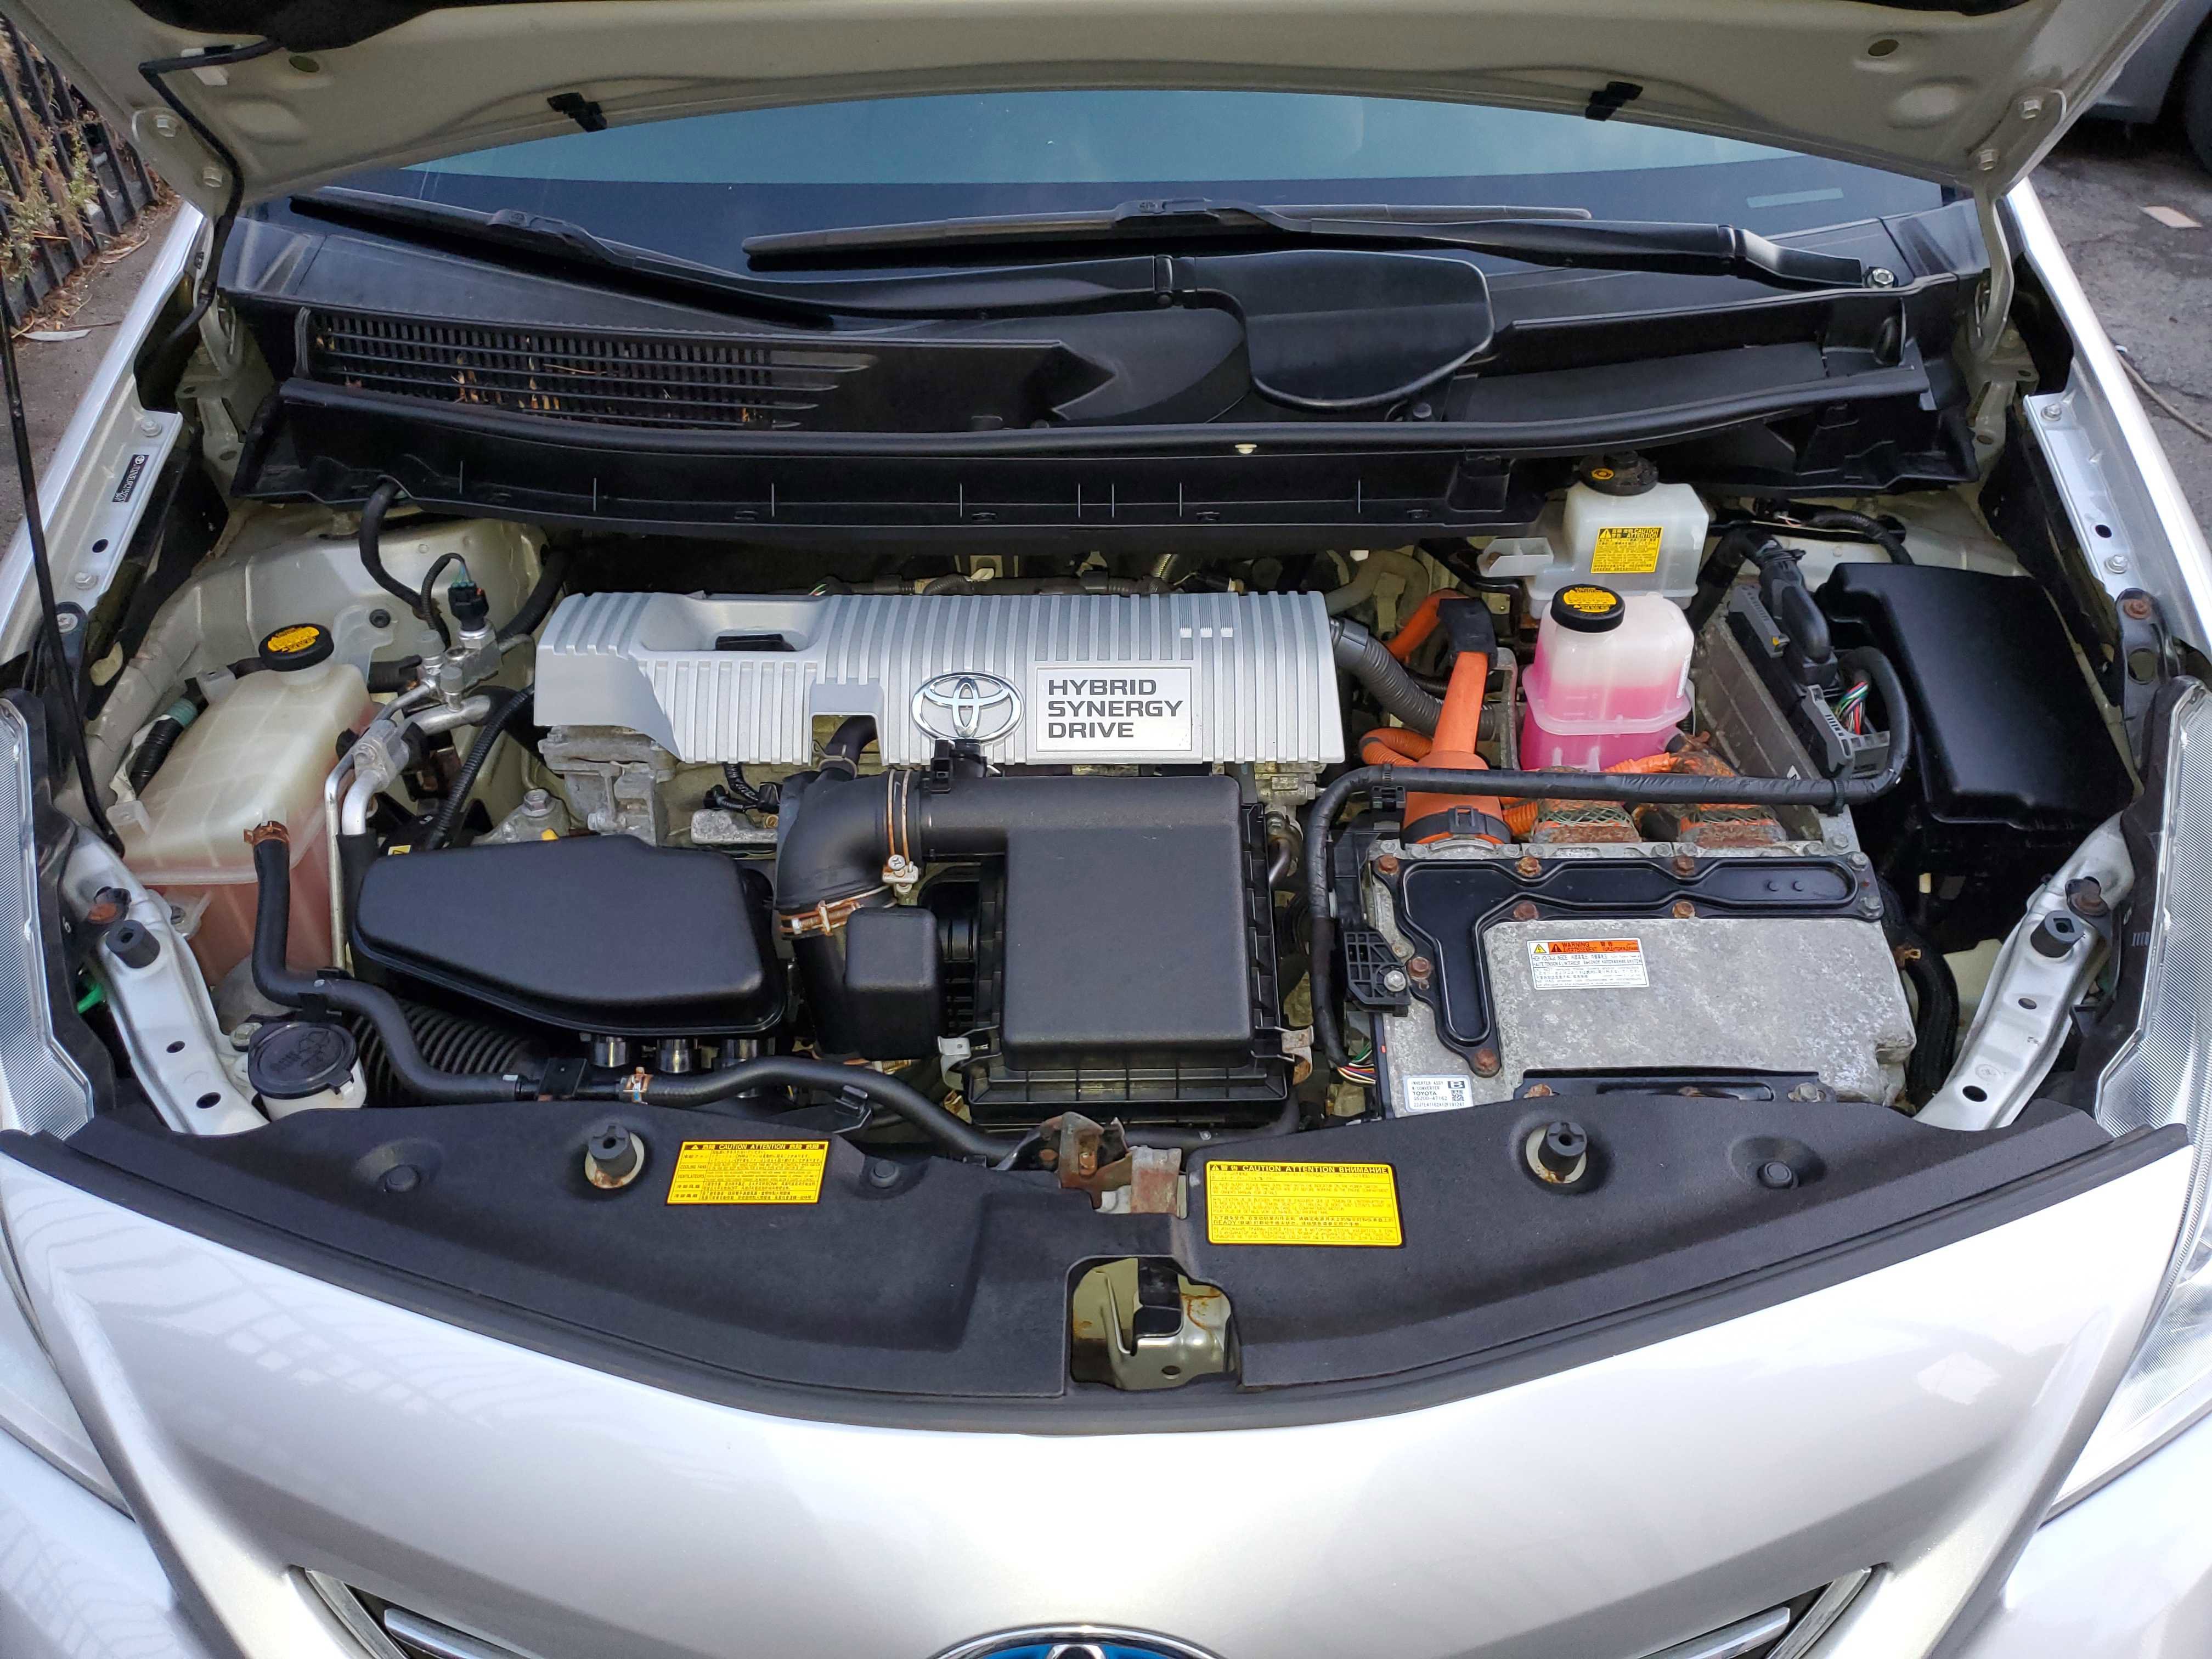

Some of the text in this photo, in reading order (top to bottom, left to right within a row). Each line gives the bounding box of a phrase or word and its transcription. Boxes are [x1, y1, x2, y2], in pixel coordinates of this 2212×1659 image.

[1048, 679, 1157, 696] HYBRID
[1048, 701, 1183, 717] SYNERGY
[1048, 722, 1135, 738] DRIVE
